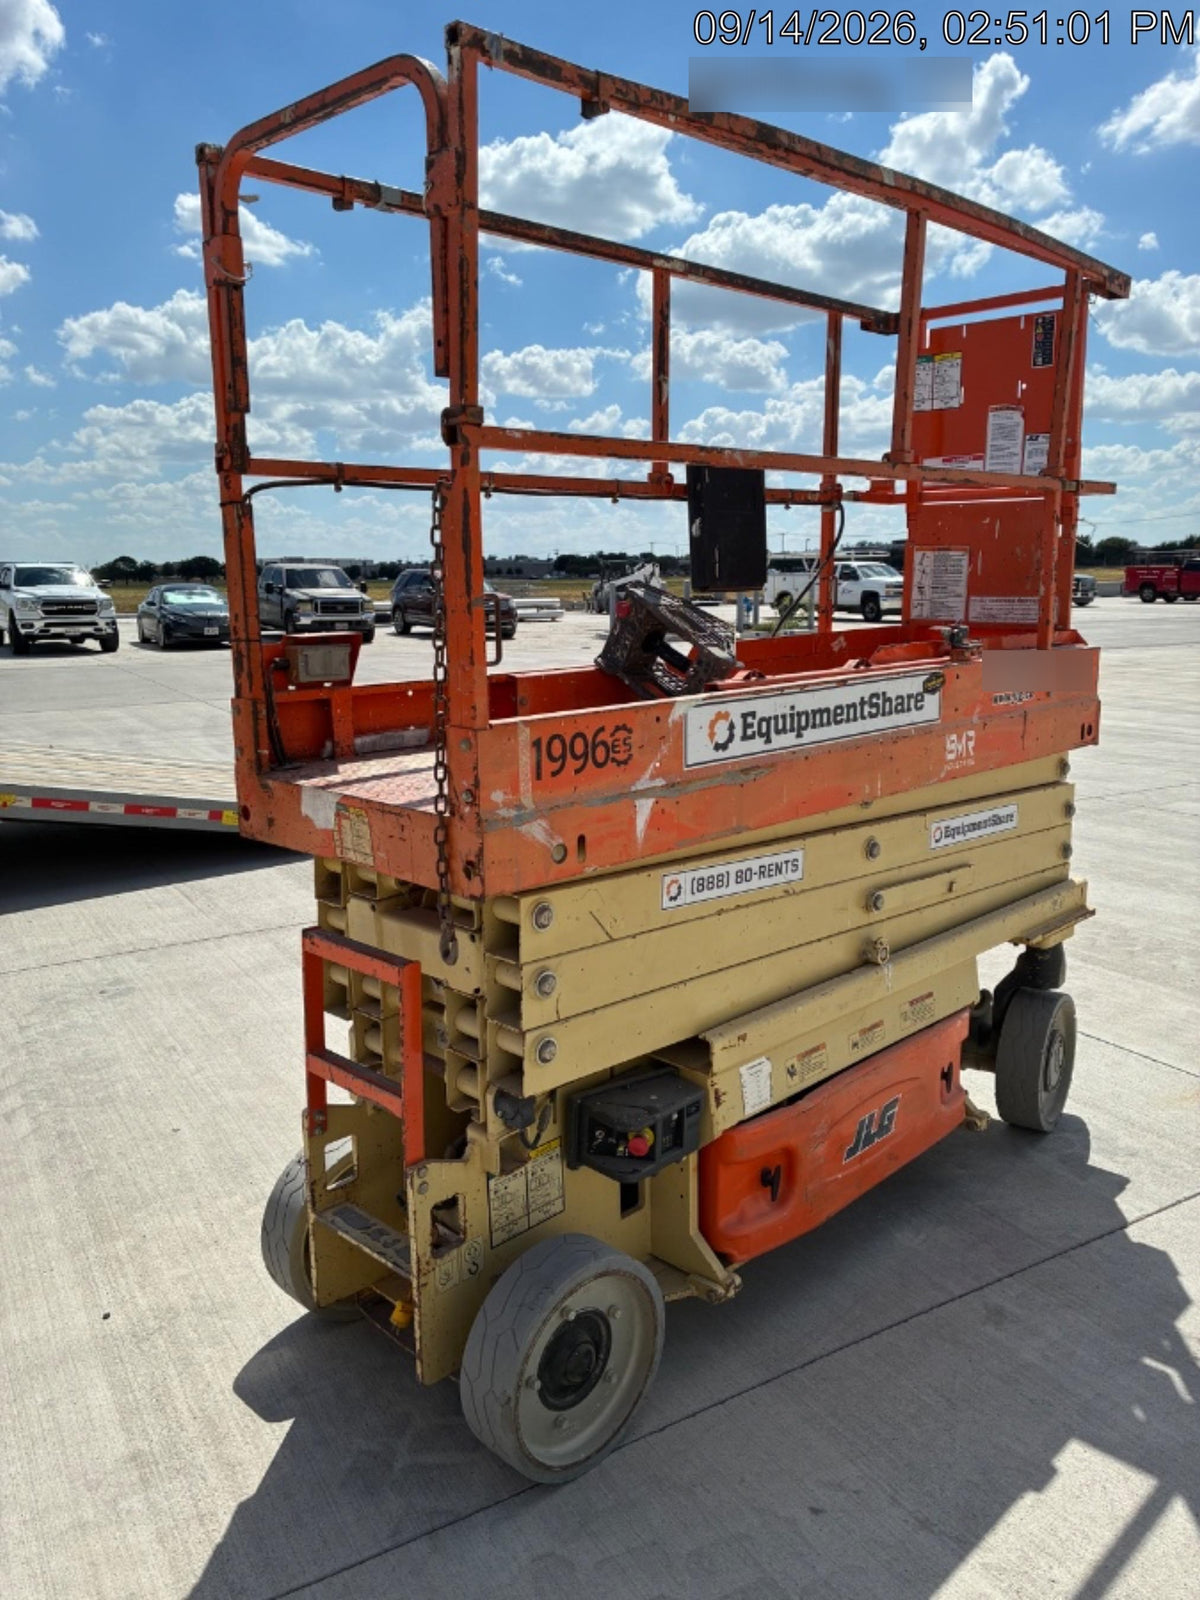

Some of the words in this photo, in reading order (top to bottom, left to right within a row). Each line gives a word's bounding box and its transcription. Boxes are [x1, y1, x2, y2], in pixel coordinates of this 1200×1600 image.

[740, 691, 925, 744] EquipmentShare
[532, 725, 610, 781] 1996
[943, 811, 1015, 840] EquipmentShare
[690, 866, 730, 896] (888)
[735, 857, 800, 885] 80-RENTS
[843, 1093, 902, 1164] JLG
